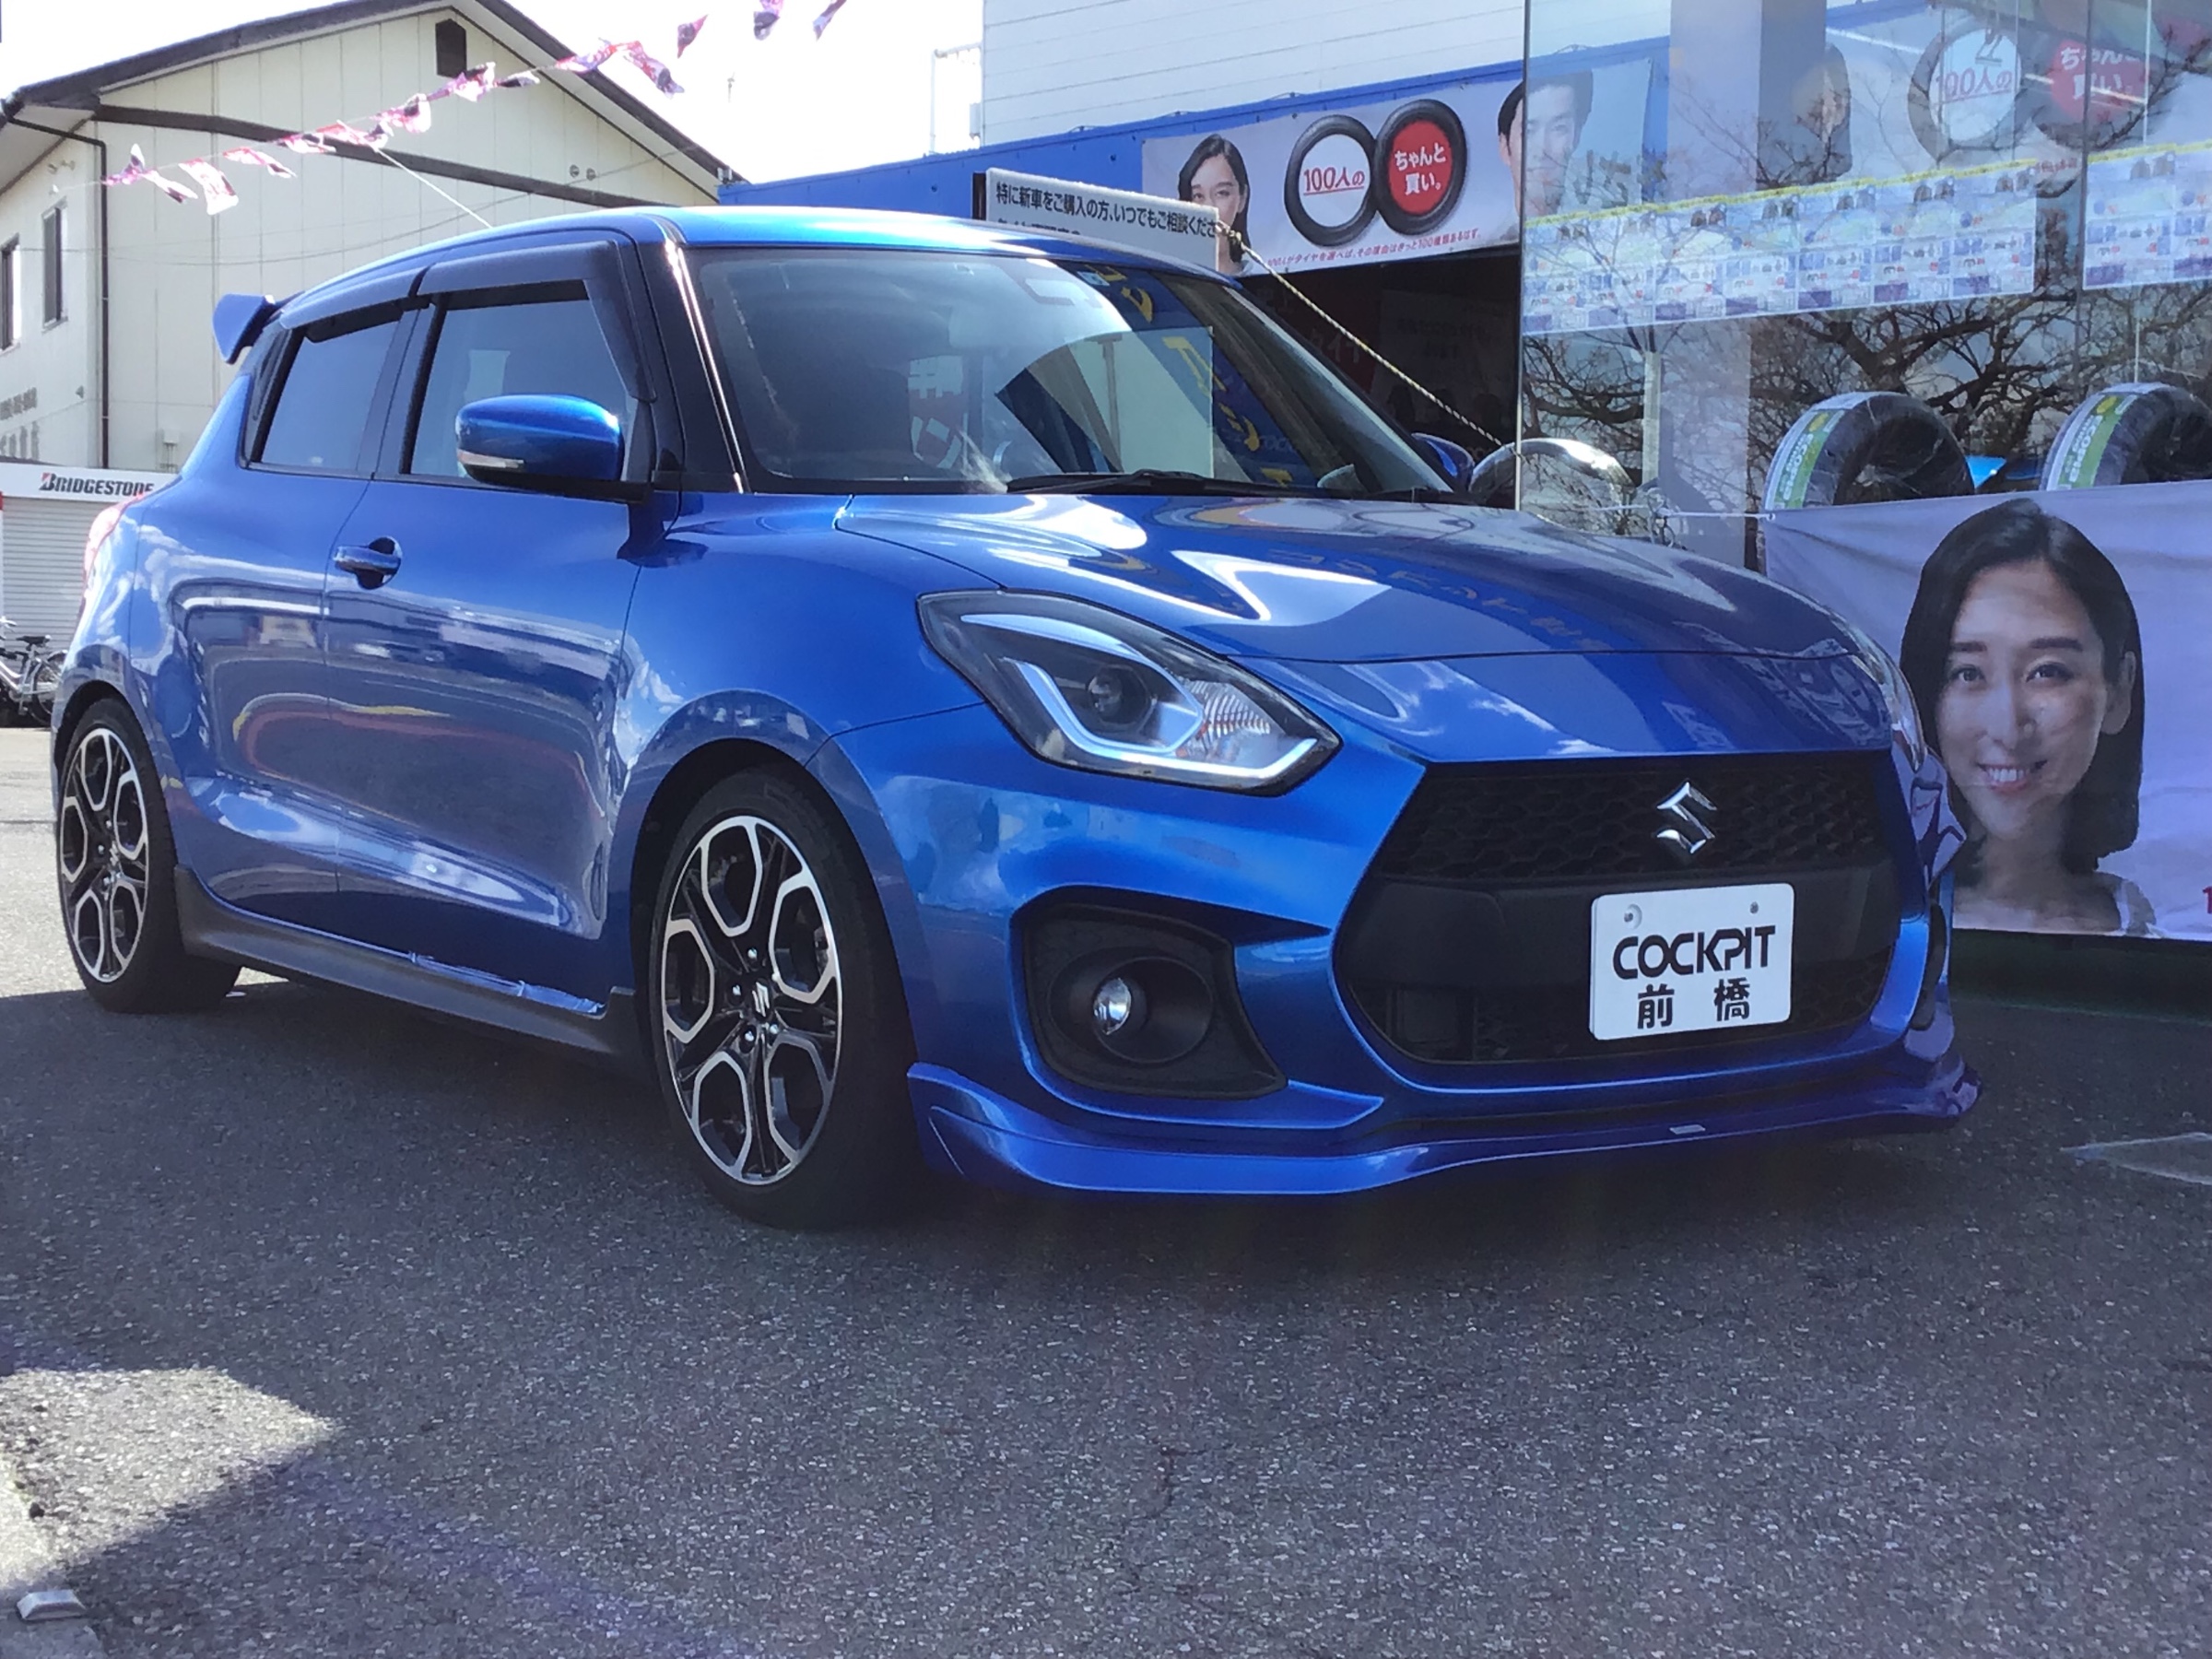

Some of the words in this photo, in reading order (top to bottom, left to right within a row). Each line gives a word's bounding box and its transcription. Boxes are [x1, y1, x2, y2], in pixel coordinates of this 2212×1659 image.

[1394, 143, 1446, 171] ちゃんと
[1303, 167, 1365, 192] 100人の
[1405, 173, 1441, 195] 買い。
[1613, 924, 1775, 980] COCKPIT
